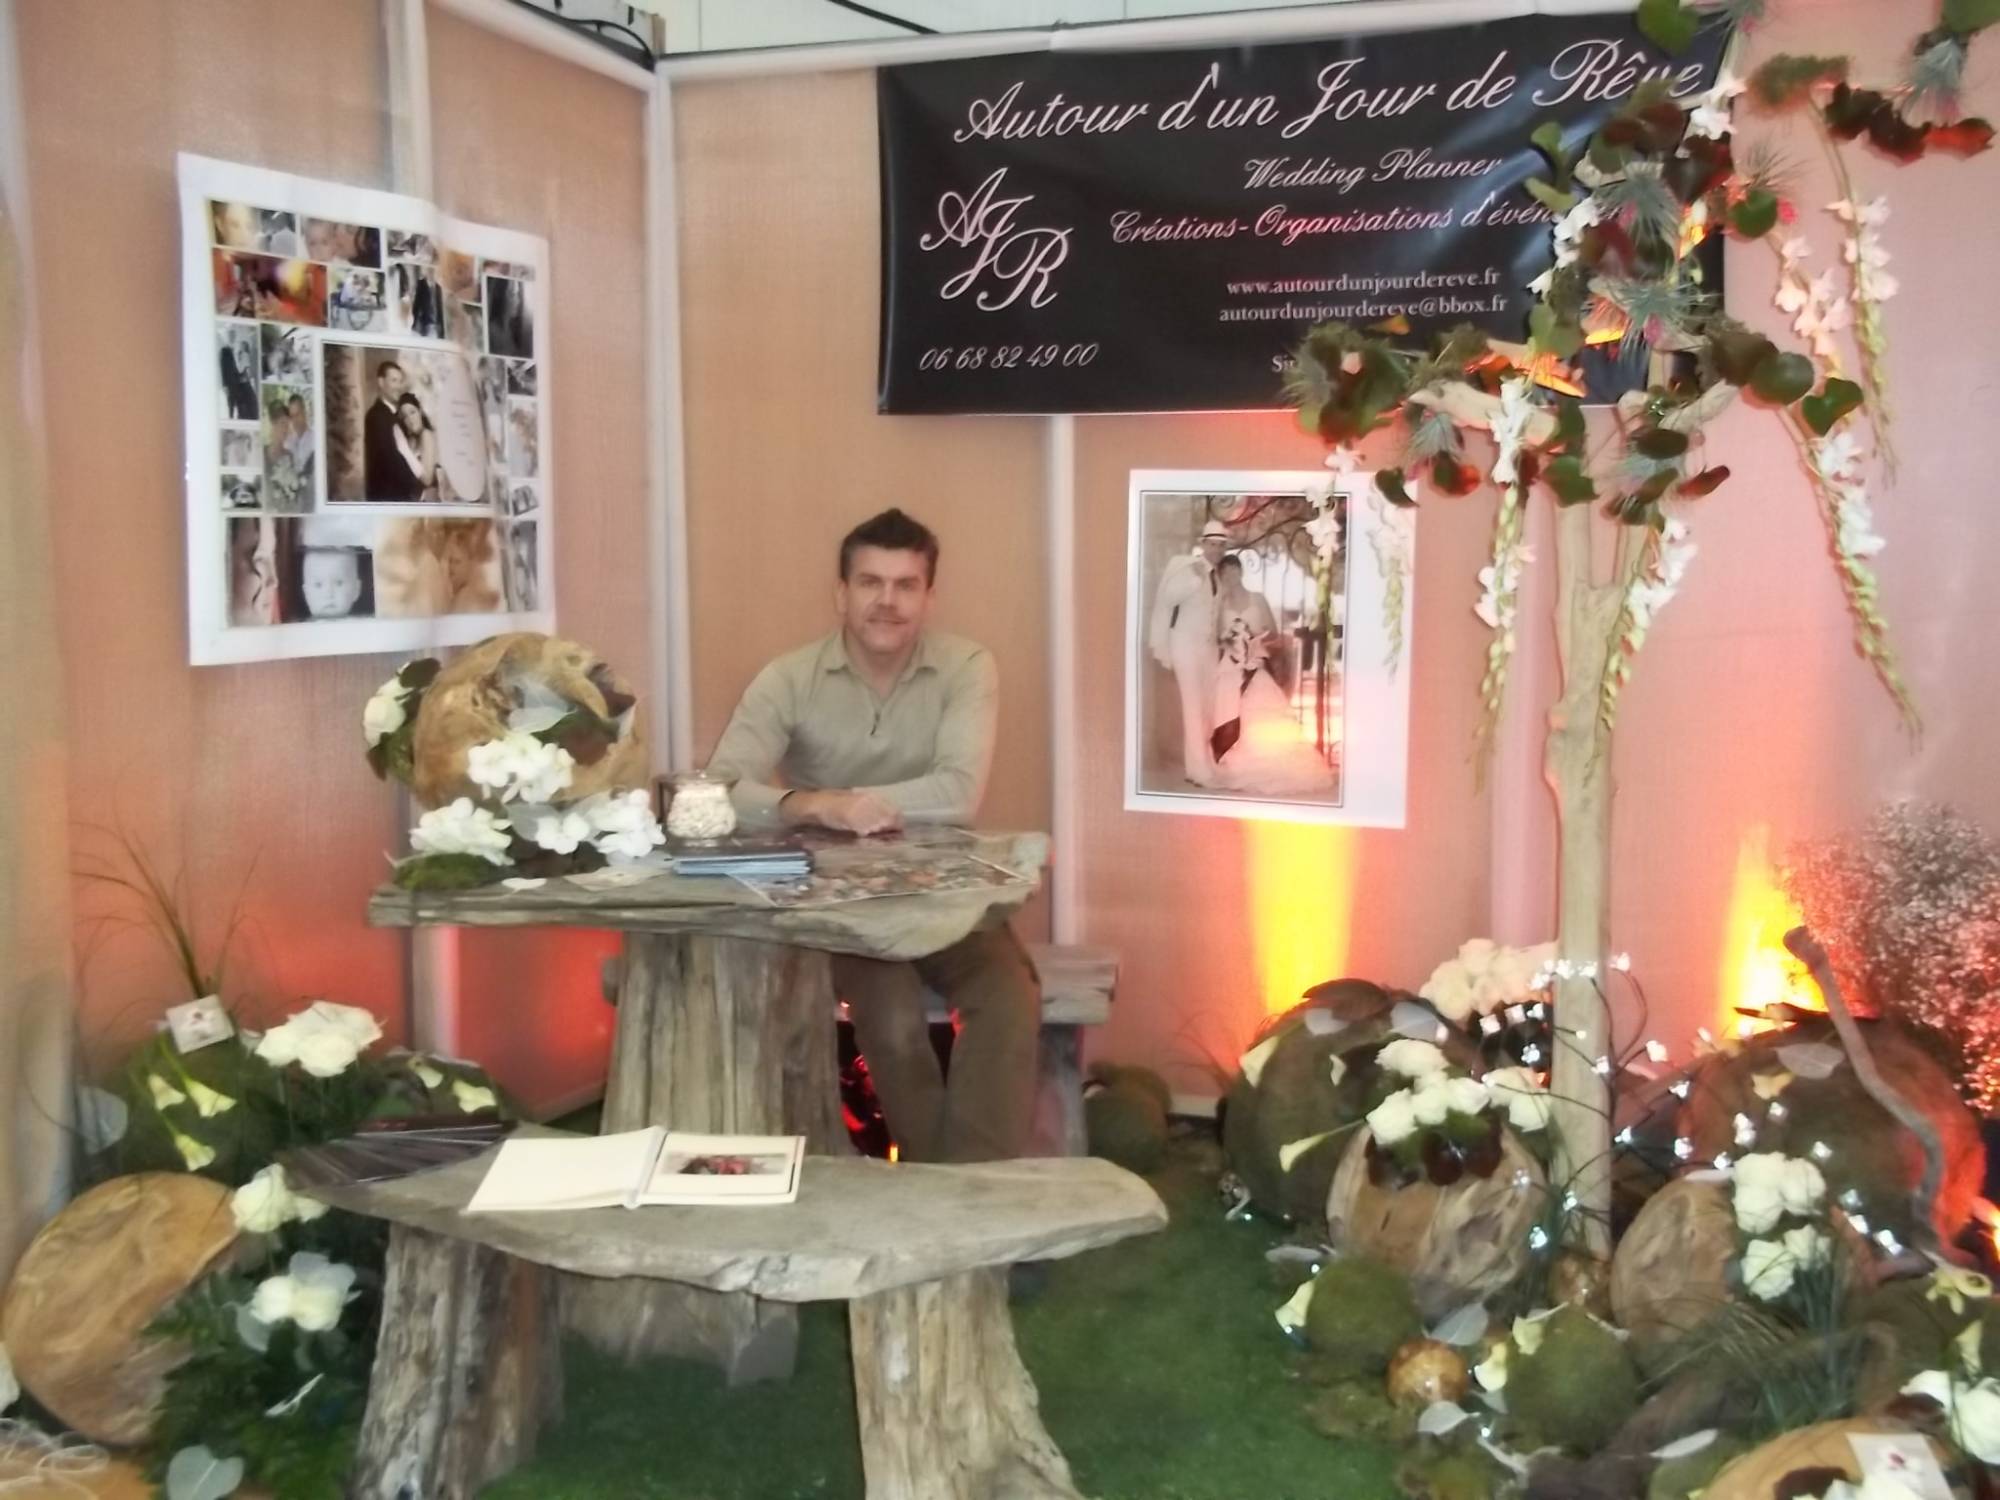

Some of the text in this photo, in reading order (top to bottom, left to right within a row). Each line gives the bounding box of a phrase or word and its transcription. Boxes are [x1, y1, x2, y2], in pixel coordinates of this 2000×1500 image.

[953, 80, 1152, 144] Autour
[1158, 61, 1280, 131] d'un
[1281, 56, 1437, 139] Jour
[1446, 50, 1516, 110] de
[1244, 147, 1502, 194] Wedding Planner
[1255, 204, 1454, 246] Organisations
[1227, 267, 1500, 295] www.autourdunjourdereve.fr
[1219, 295, 1509, 323] autourdunjourdereve@bbox.fr
[919, 343, 1099, 371] 06 68 82 49 00
